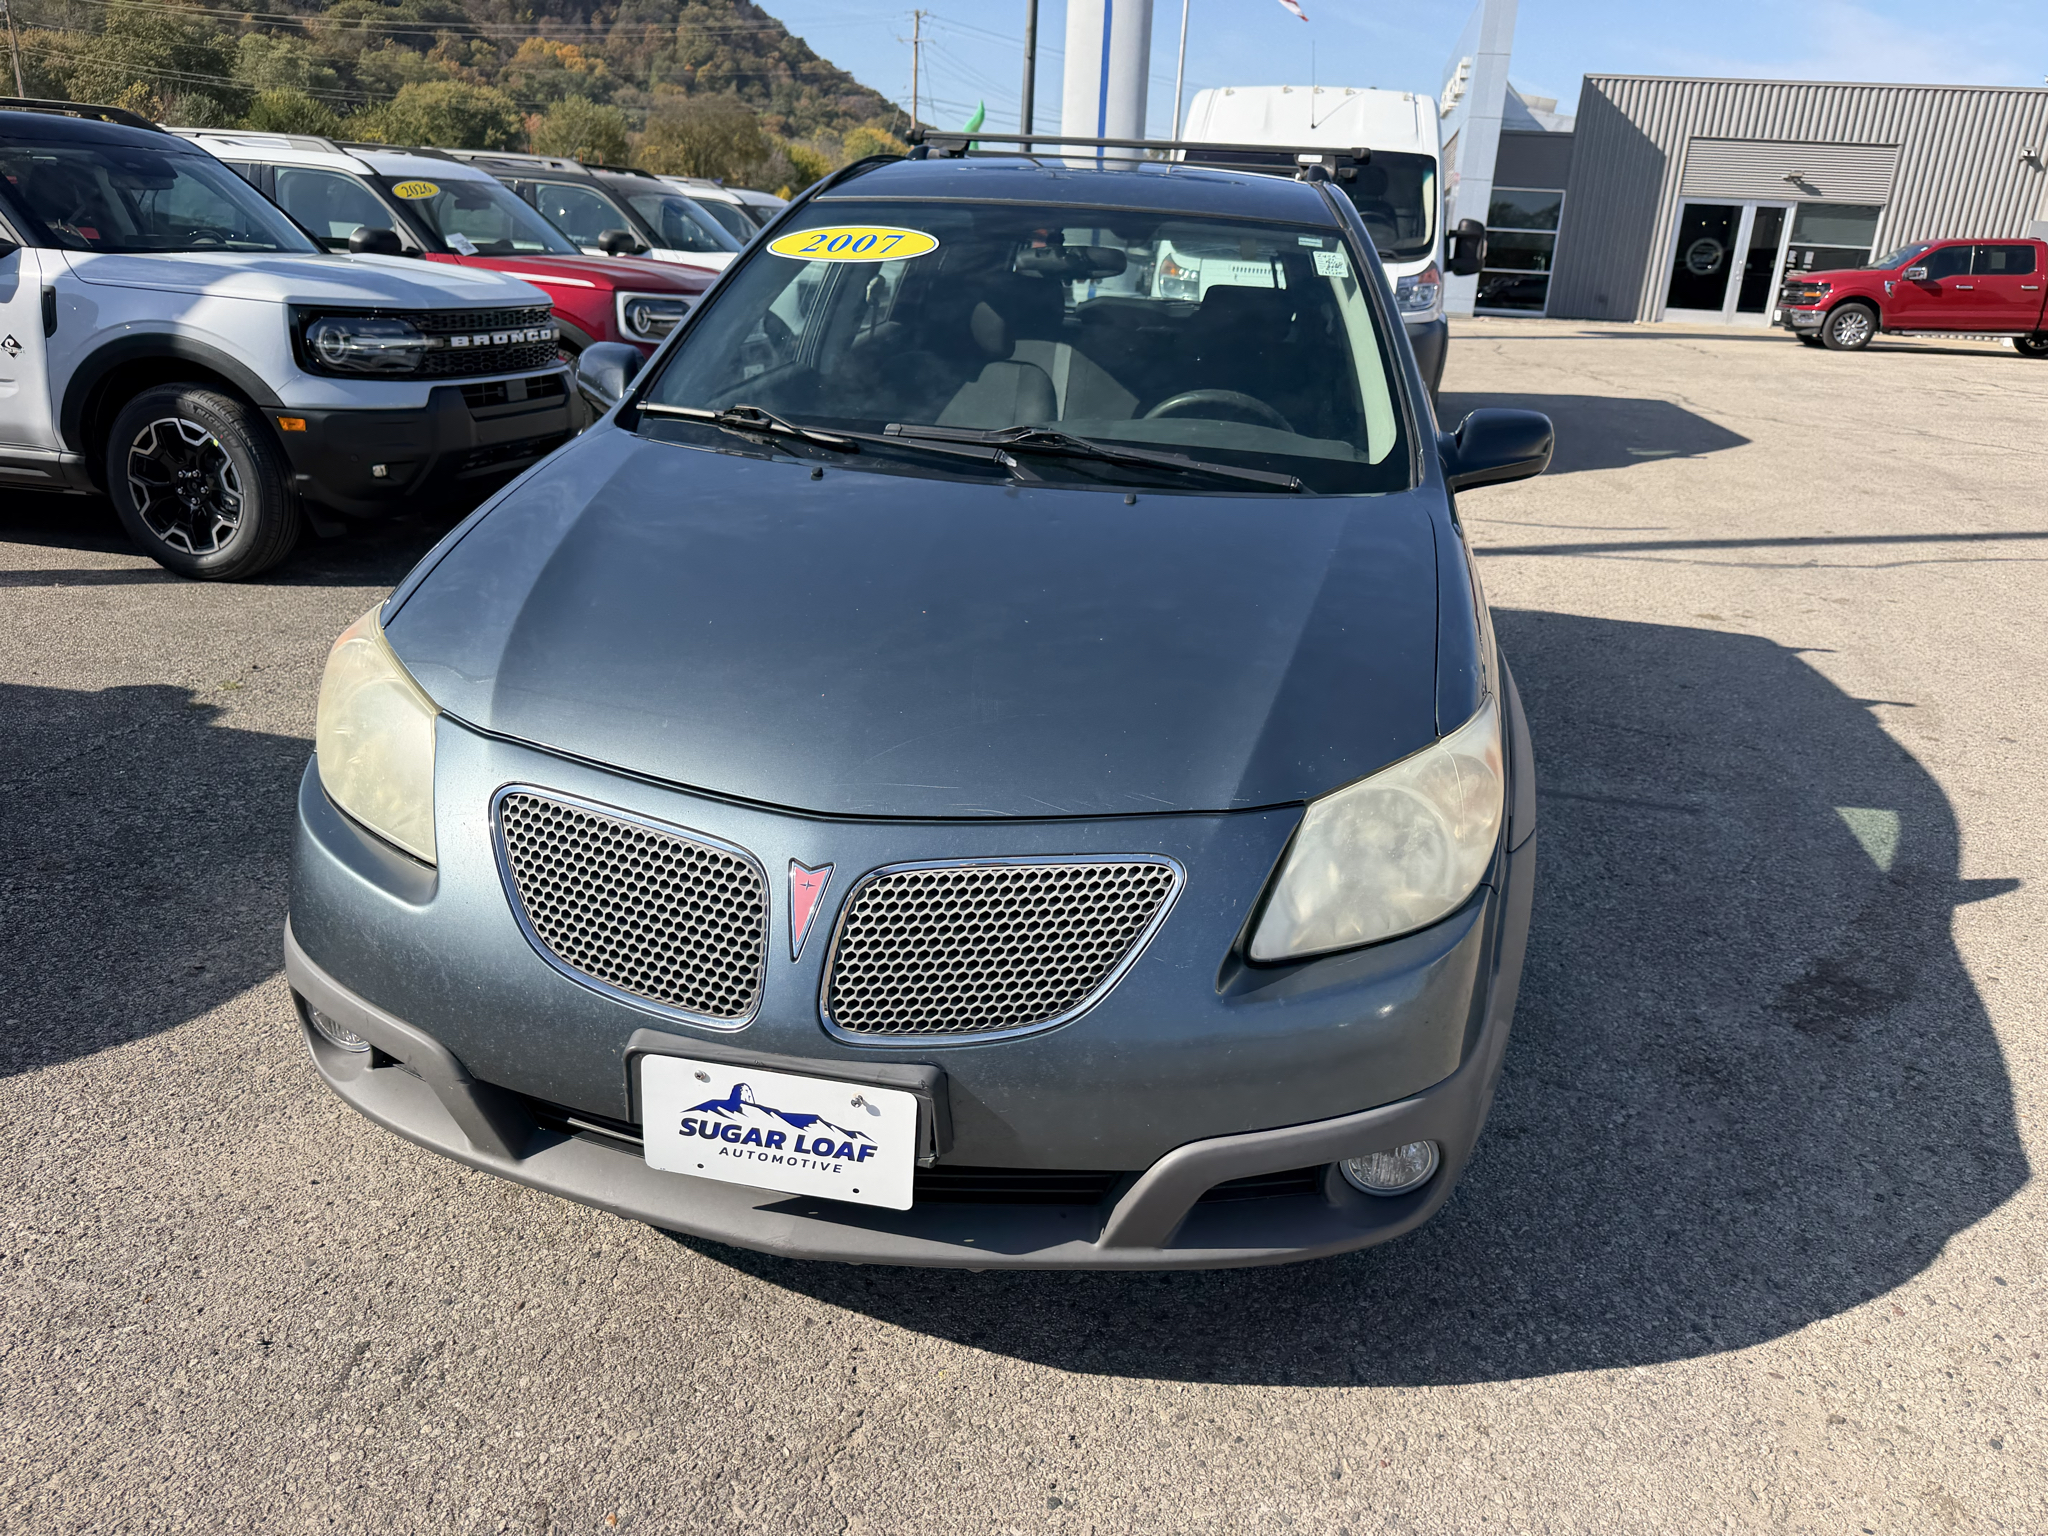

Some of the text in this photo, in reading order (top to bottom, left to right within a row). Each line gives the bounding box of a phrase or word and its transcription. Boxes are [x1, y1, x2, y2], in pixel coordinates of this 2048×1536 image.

[401, 183, 432, 197] 2026
[798, 234, 905, 254] 2007
[450, 329, 552, 347] BRONCO
[680, 1117, 878, 1163] SUGAR LOAF
[718, 1146, 843, 1174] AUTOMOTIVE
